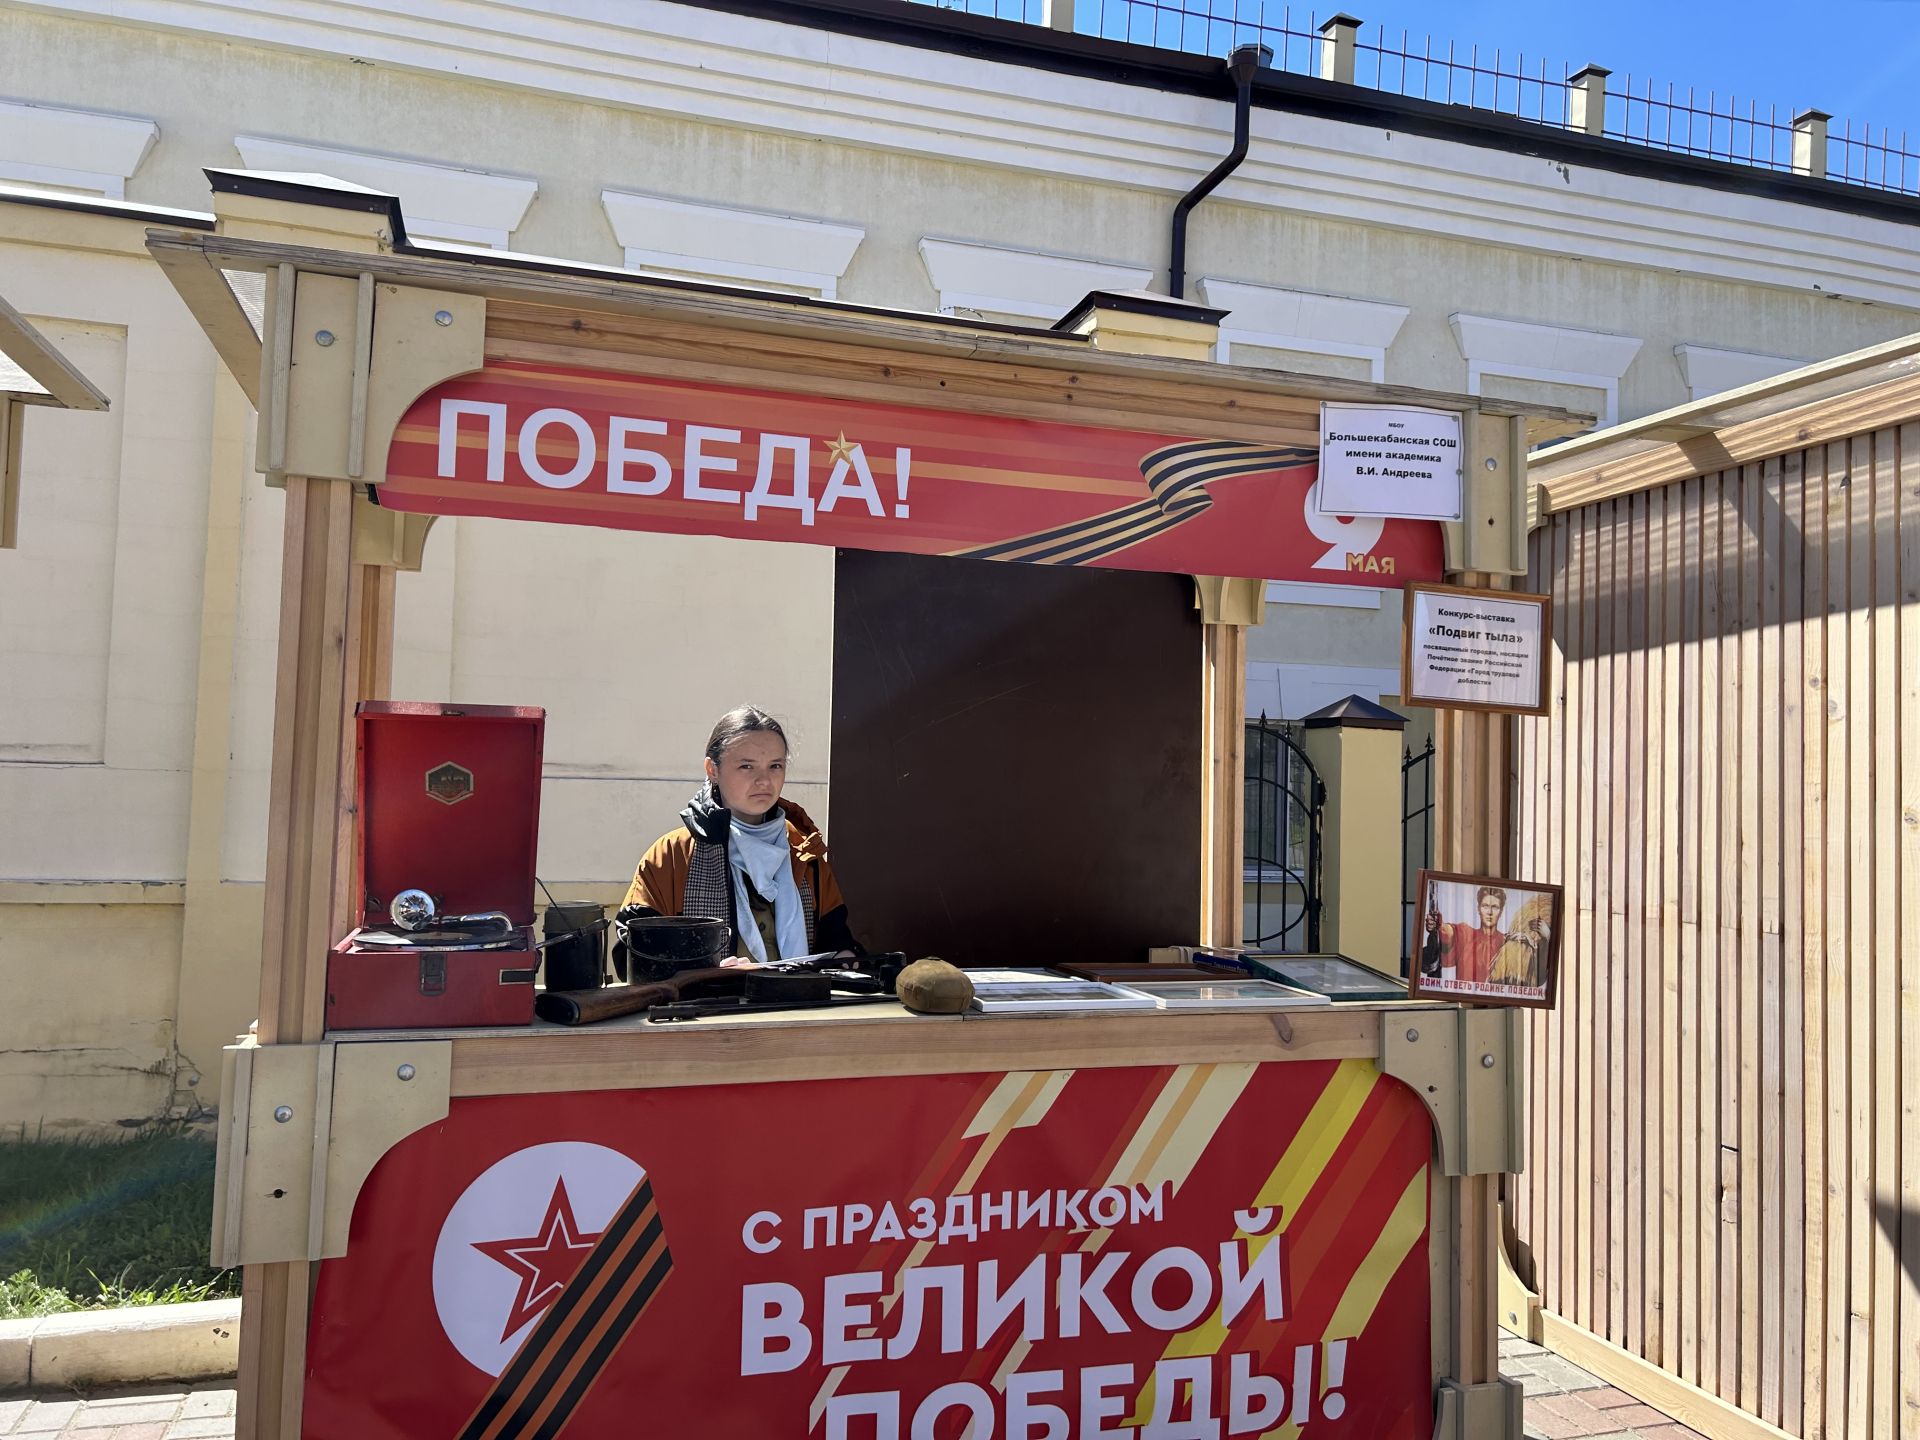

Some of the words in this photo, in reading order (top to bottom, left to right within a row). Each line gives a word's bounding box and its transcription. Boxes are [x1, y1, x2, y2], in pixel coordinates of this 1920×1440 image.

[1329, 432, 1429, 446] Большекабанская
[1433, 438, 1457, 448] СОШ
[438, 398, 911, 526] ПОБЕДА!
[1346, 450, 1382, 458] имени
[1385, 451, 1441, 462] академика
[1356, 466, 1378, 476] В.И.
[1382, 468, 1432, 479] Андреева
[1346, 553, 1395, 575] МАЯ
[1438, 608, 1515, 623] Конкурс-выставка
[1429, 625, 1481, 640] «Подвиг
[1485, 632, 1523, 643] тыла»
[1429, 664, 1465, 673] Федерации
[1420, 977, 1443, 989] ВОИН,
[1444, 981, 1472, 990] ОТВЕТЬ
[1475, 983, 1503, 992] РОДИНЕ
[741, 1210, 782, 1254] С
[803, 1183, 1164, 1249] ПРАЗДНИКОМ
[741, 1206, 1284, 1376] ВЕЛИКОЙ
[826, 1339, 1348, 1440] ПОБЕДЫ!
